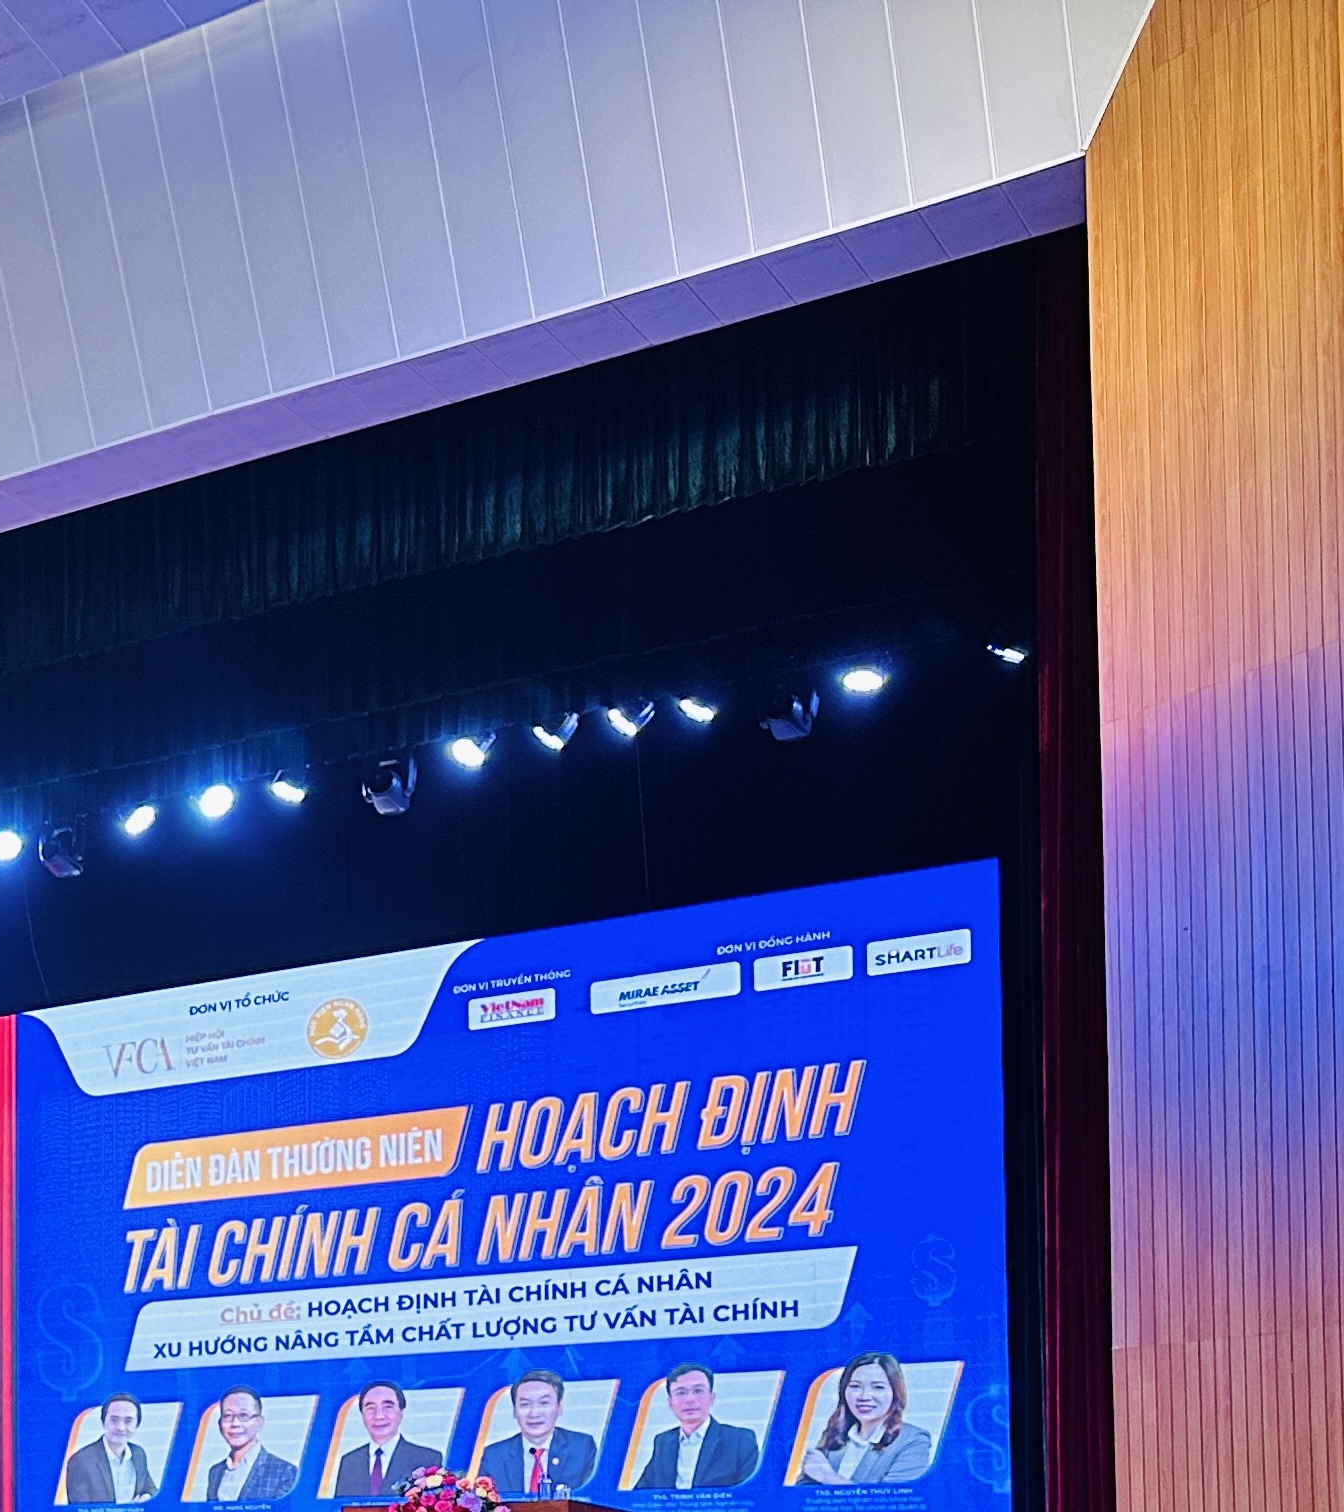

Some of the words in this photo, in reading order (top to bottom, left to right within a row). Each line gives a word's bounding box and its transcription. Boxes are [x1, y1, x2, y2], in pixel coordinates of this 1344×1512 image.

[716, 943, 743, 956] ĐƠN
[189, 1003, 217, 1016] ĐƠN
[219, 1000, 232, 1012] VỊ
[254, 990, 290, 1005] CHỨC
[619, 985, 659, 1001] MIRAE
[660, 980, 700, 996] ASSET
[476, 1080, 692, 1174] HOẠCH
[696, 1059, 868, 1156] ĐỊNH
[208, 1148, 261, 1187] ĐÀN
[267, 1135, 372, 1180] THƯỜNG
[379, 1126, 443, 1168] NIÊN
[123, 1216, 203, 1295] TÀI
[207, 1203, 382, 1289] CHÍNH
[387, 1188, 467, 1273] CÁ
[476, 1175, 656, 1265] NHÂN
[661, 1161, 841, 1250] 2024
[220, 1303, 262, 1325] Chủ
[308, 1295, 390, 1319] HOẠCH
[395, 1290, 457, 1314] ĐỊNH
[463, 1284, 501, 1306] TÀI
[508, 1278, 587, 1302] CHÍNH
[595, 1273, 630, 1297] CÁ
[637, 1268, 712, 1294] NHÂN
[153, 1341, 182, 1359] XU
[188, 1334, 268, 1357] HƯỚNG
[274, 1329, 340, 1351] NÂNG
[345, 1323, 394, 1347] TẦM
[401, 1317, 465, 1343] CHẤT
[472, 1315, 558, 1341] LƯỢNG
[564, 1310, 598, 1333] TƯ
[602, 1304, 657, 1330] VẤN
[664, 1302, 705, 1326] TÀI
[713, 1297, 799, 1323] CHÍNH
